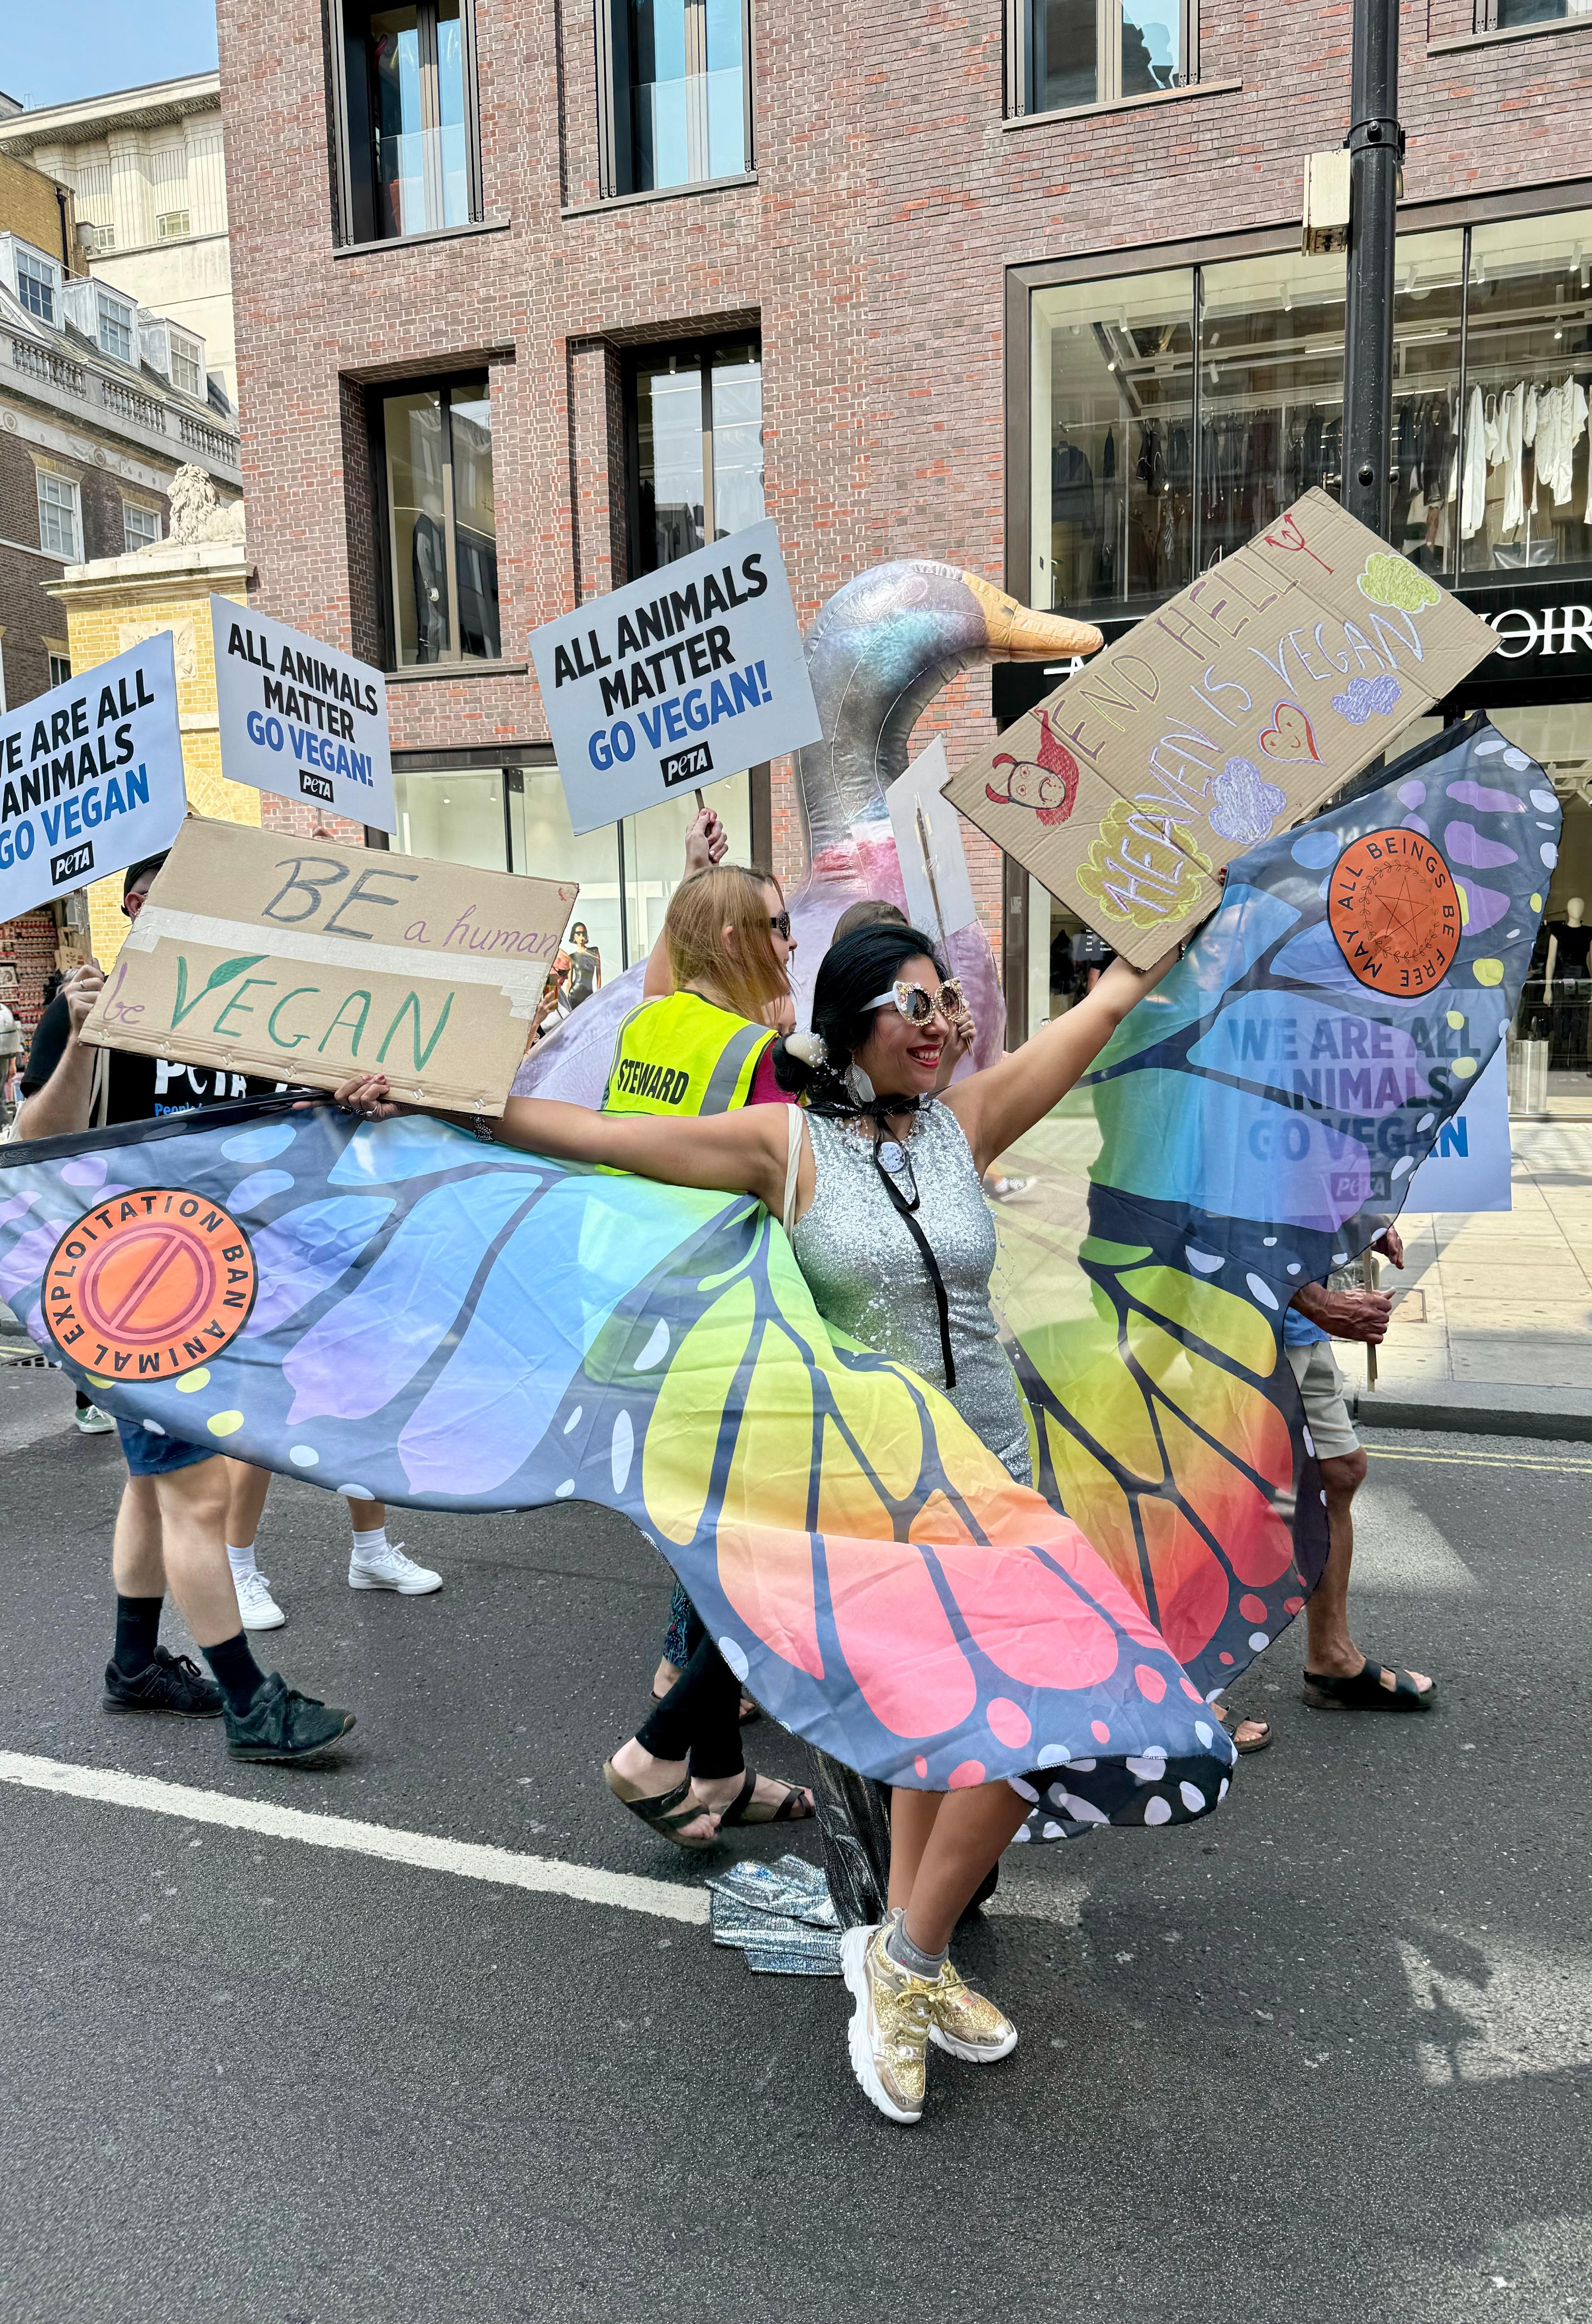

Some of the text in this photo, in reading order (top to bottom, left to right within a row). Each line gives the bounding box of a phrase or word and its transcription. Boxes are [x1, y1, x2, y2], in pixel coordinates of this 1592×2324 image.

[228, 623, 378, 716] ALL ANIMALS
[555, 553, 767, 688] ALL ANIMALS
[599, 625, 736, 717] MATTER
[1052, 556, 1300, 763] END HELL
[0, 668, 154, 778] E ARE ALL
[247, 710, 373, 787] GO VEGAN!
[263, 675, 355, 743] MATTER
[589, 660, 772, 771] GO VEGAN!
[1, 723, 134, 823] ANIMALS
[1103, 609, 1425, 913] HEAVEN IS VEGAN
[0, 763, 149, 869] GO VEGAN
[262, 856, 558, 958] BE a human
[1338, 837, 1454, 987] MAY ALL BEINGS BE FREE
[103, 955, 455, 1072] be VEGAN
[1228, 1017, 1481, 1061] WE ARE ALL
[617, 1059, 689, 1105] STEWARD
[1260, 1067, 1451, 1110] ANIMALS
[1248, 1116, 1469, 1162] GO VEGAN
[50, 1195, 248, 1374] BAN ANIMAL EXPLOITATION
